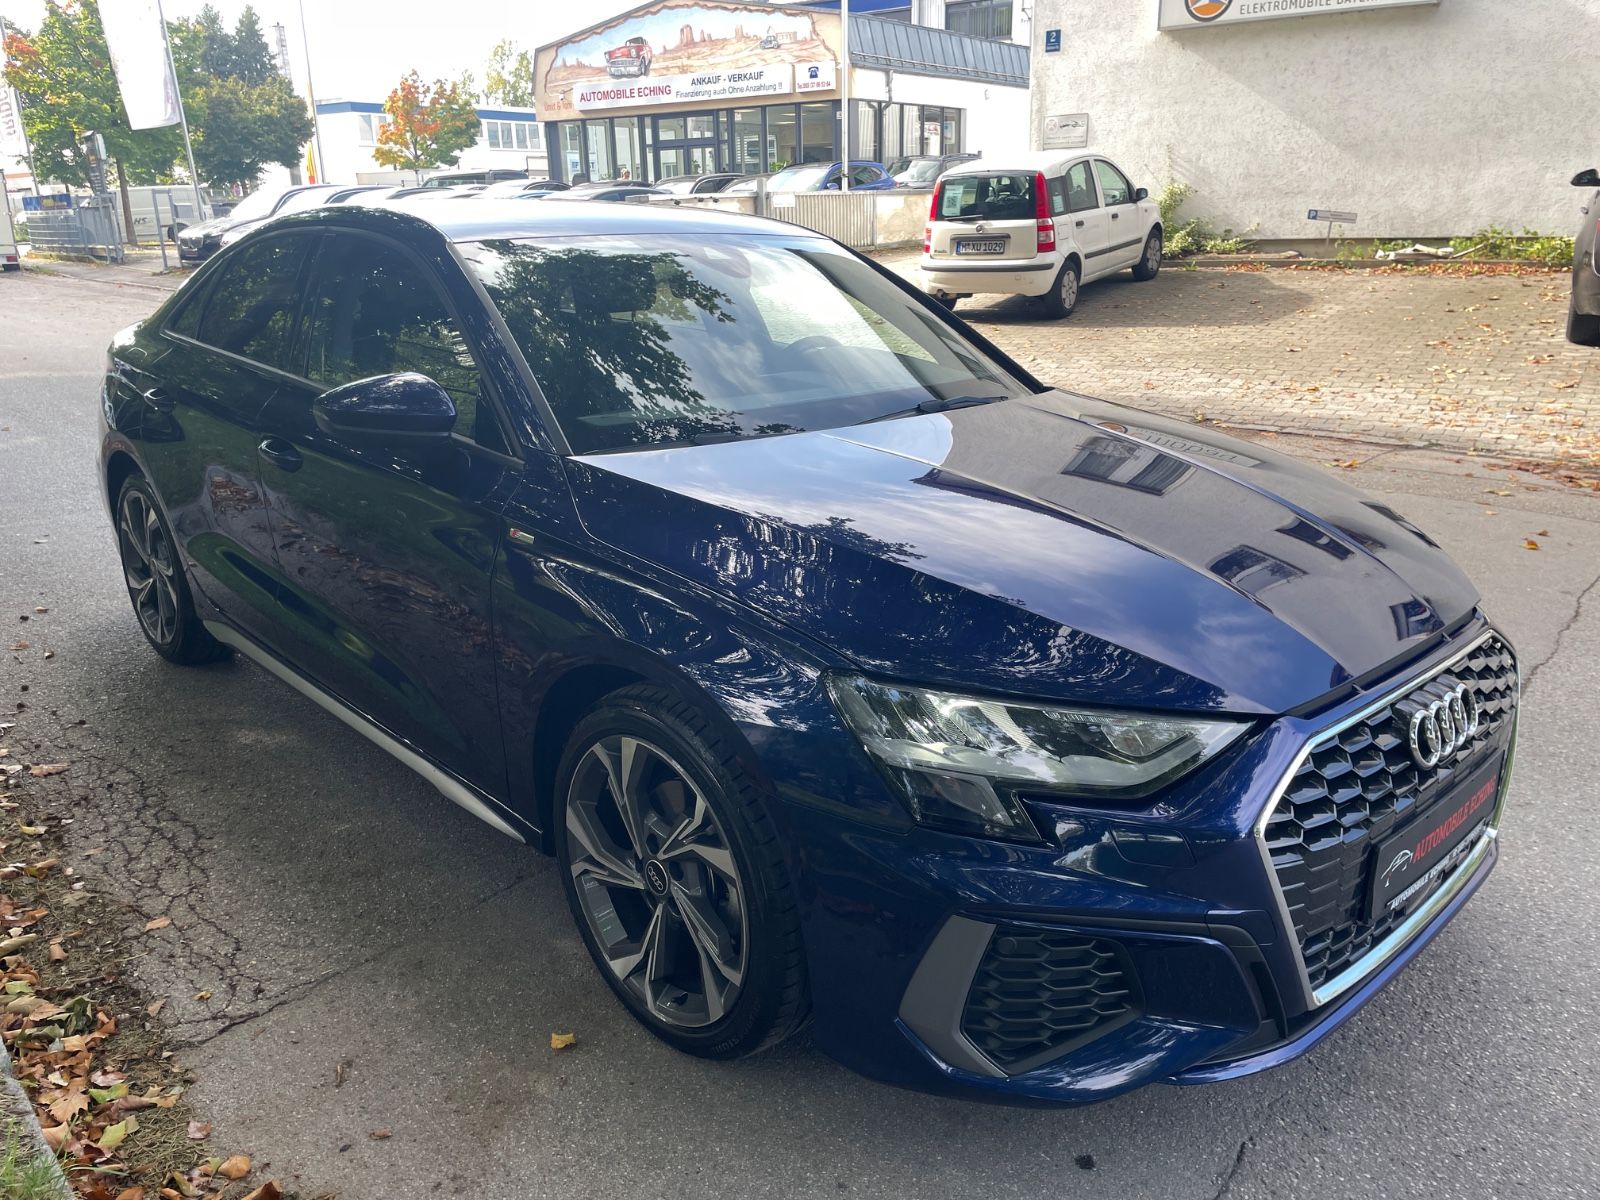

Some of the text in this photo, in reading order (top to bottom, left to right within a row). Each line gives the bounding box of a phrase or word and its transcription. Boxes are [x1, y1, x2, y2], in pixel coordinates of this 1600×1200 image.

[1050, 32, 1056, 42] 2
[691, 74, 721, 86] ANKAUF
[728, 71, 764, 83] VERKAUF
[580, 84, 672, 103] AUTOMOBILE ECHING
[675, 88, 712, 99] Finanzierung
[713, 87, 727, 96] auch
[728, 84, 745, 94] Ohne
[745, 82, 777, 93] Anzahlung
[983, 242, 1004, 252] 1029
[1411, 800, 1470, 864] AUTOMOBILE
[1469, 774, 1497, 816] ECHING
